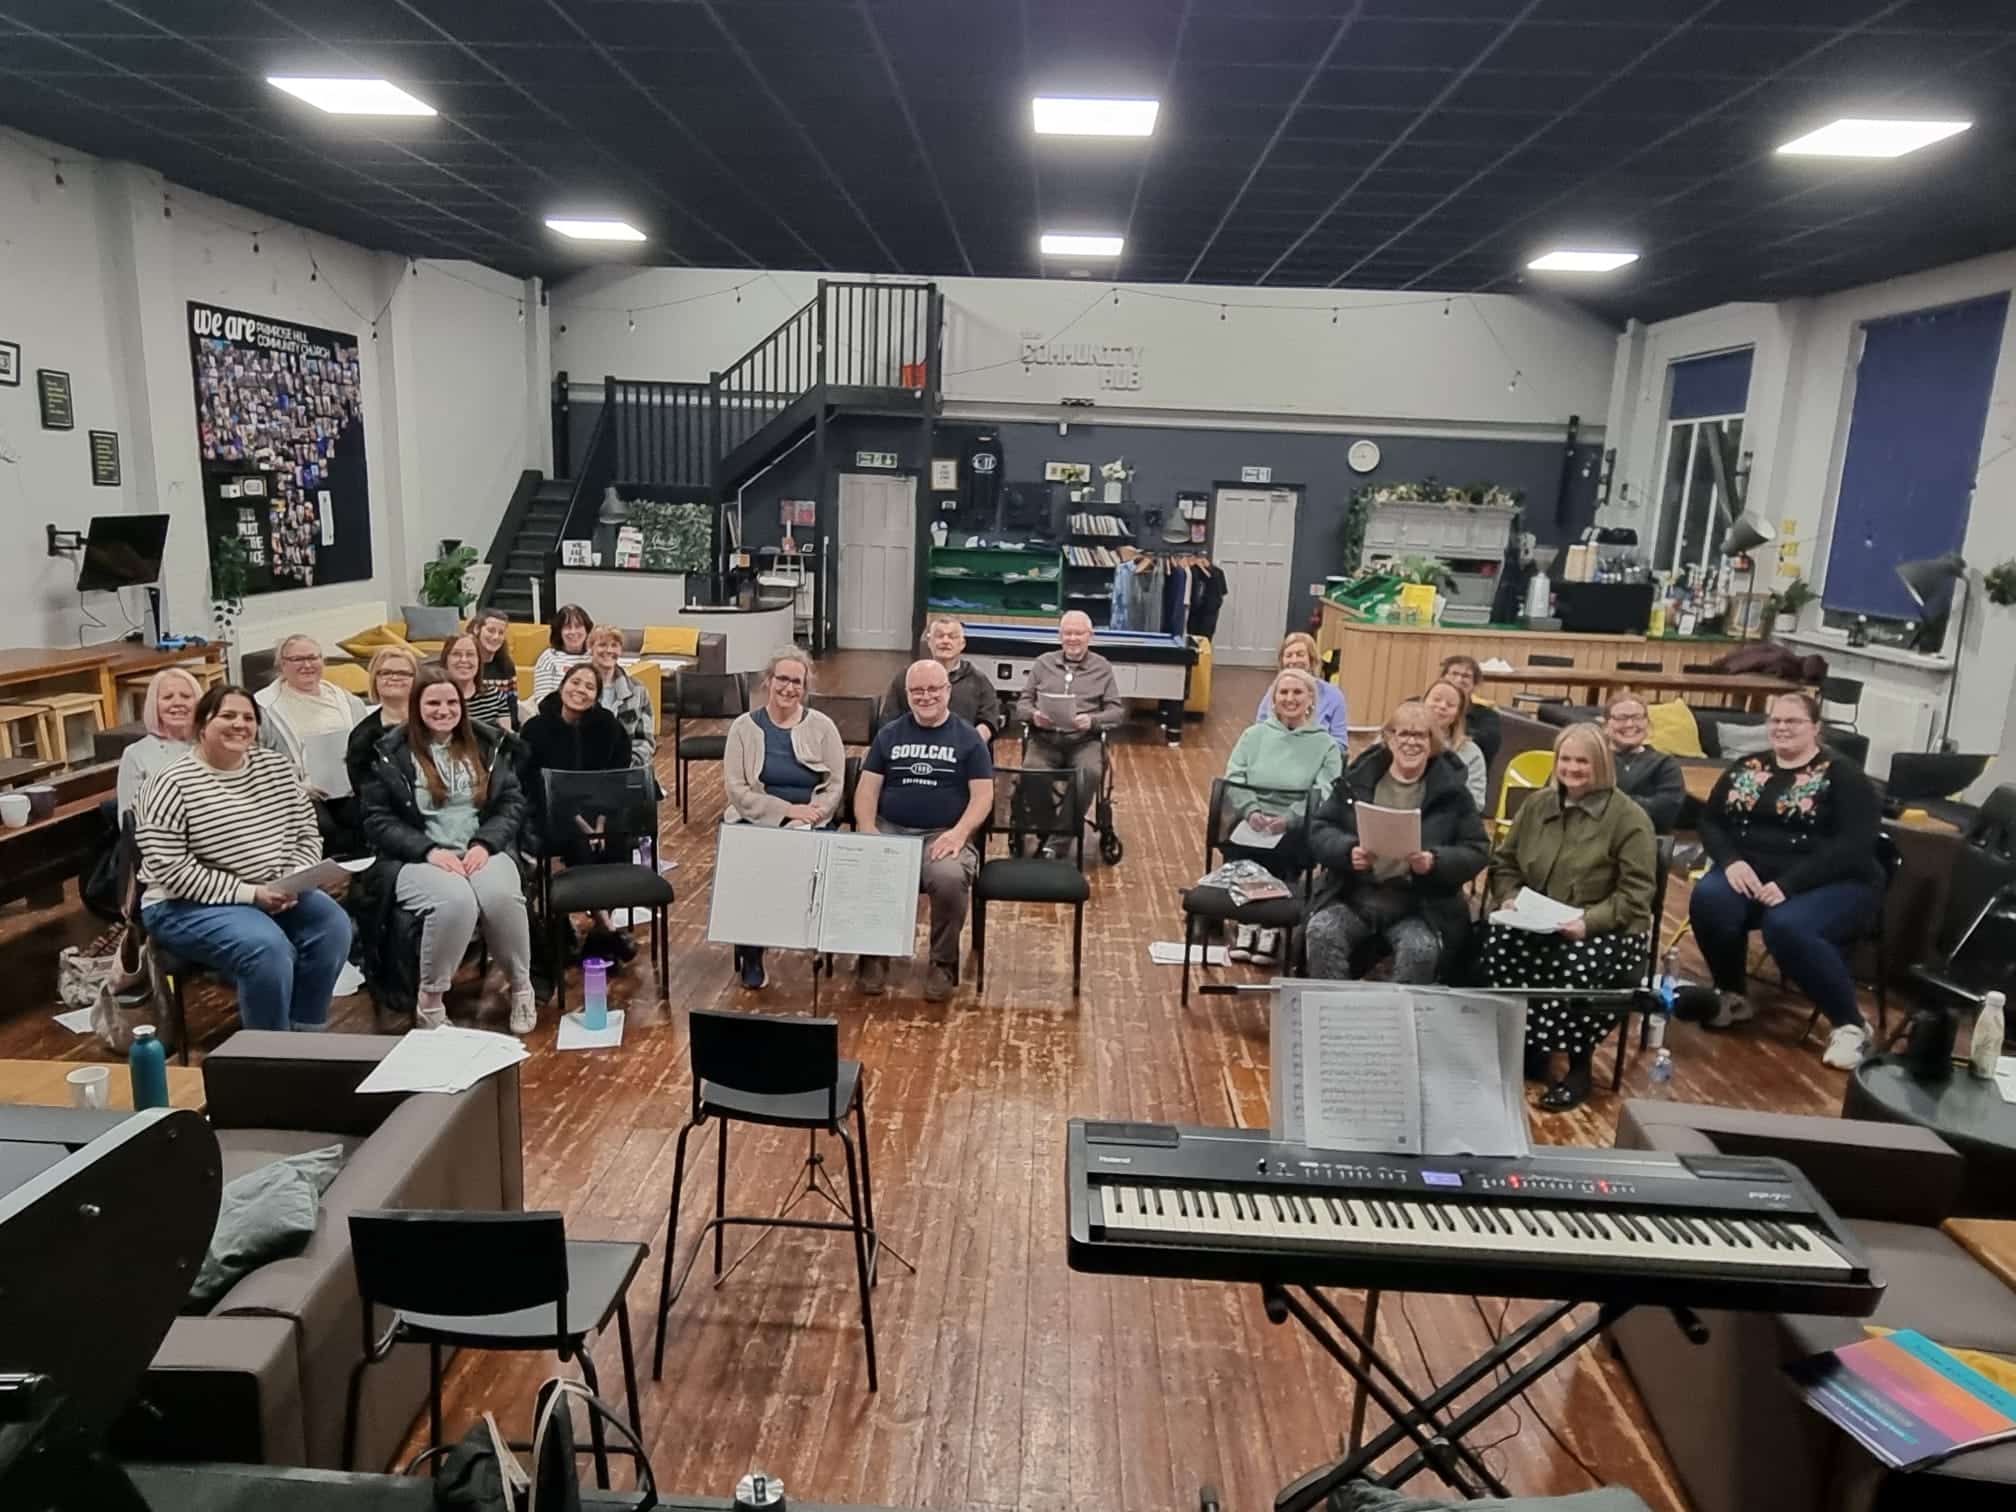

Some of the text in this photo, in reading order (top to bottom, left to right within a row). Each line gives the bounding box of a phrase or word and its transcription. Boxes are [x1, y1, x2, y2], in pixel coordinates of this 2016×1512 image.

[194, 309, 256, 342] we are
[257, 335, 300, 354] COMMUNITY
[293, 329, 309, 344] HILL
[1020, 343, 1144, 367] COMMUNITY
[1100, 369, 1142, 391] HUB
[891, 744, 957, 763] SOULCAL
